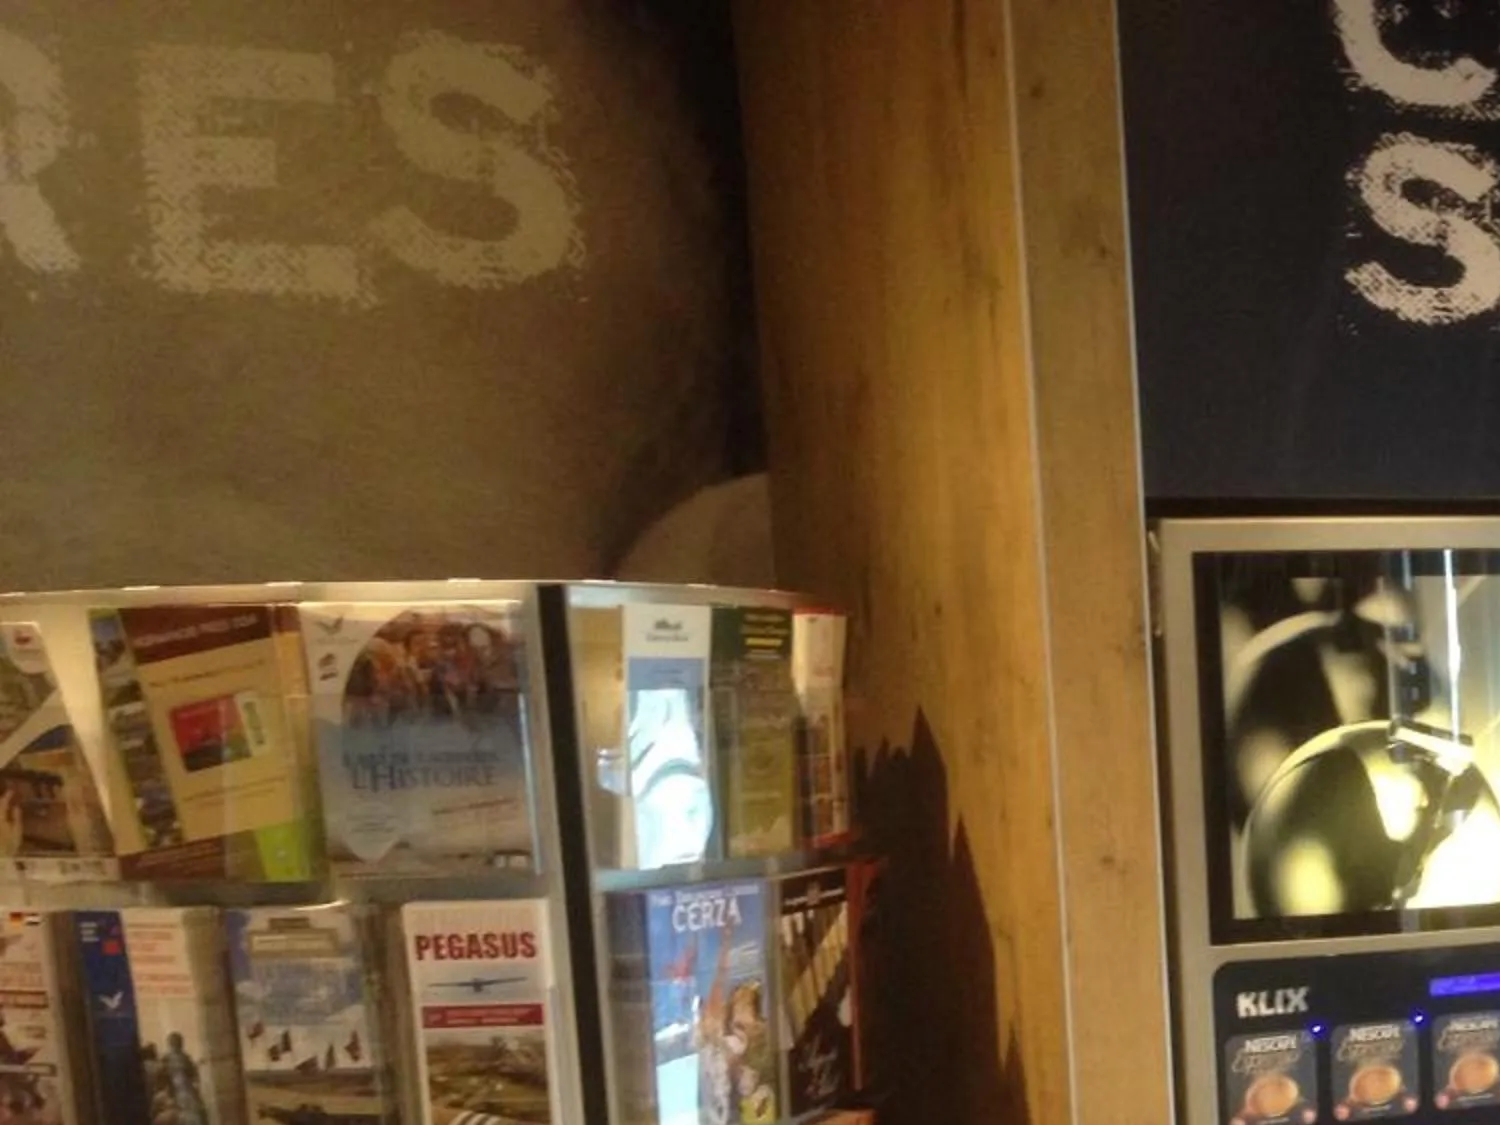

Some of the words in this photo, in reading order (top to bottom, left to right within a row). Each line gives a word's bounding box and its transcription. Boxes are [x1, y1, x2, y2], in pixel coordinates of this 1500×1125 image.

[671, 896, 743, 933] CERZA
[414, 931, 537, 961] PEGASUS
[1236, 985, 1310, 1019] KLIX
